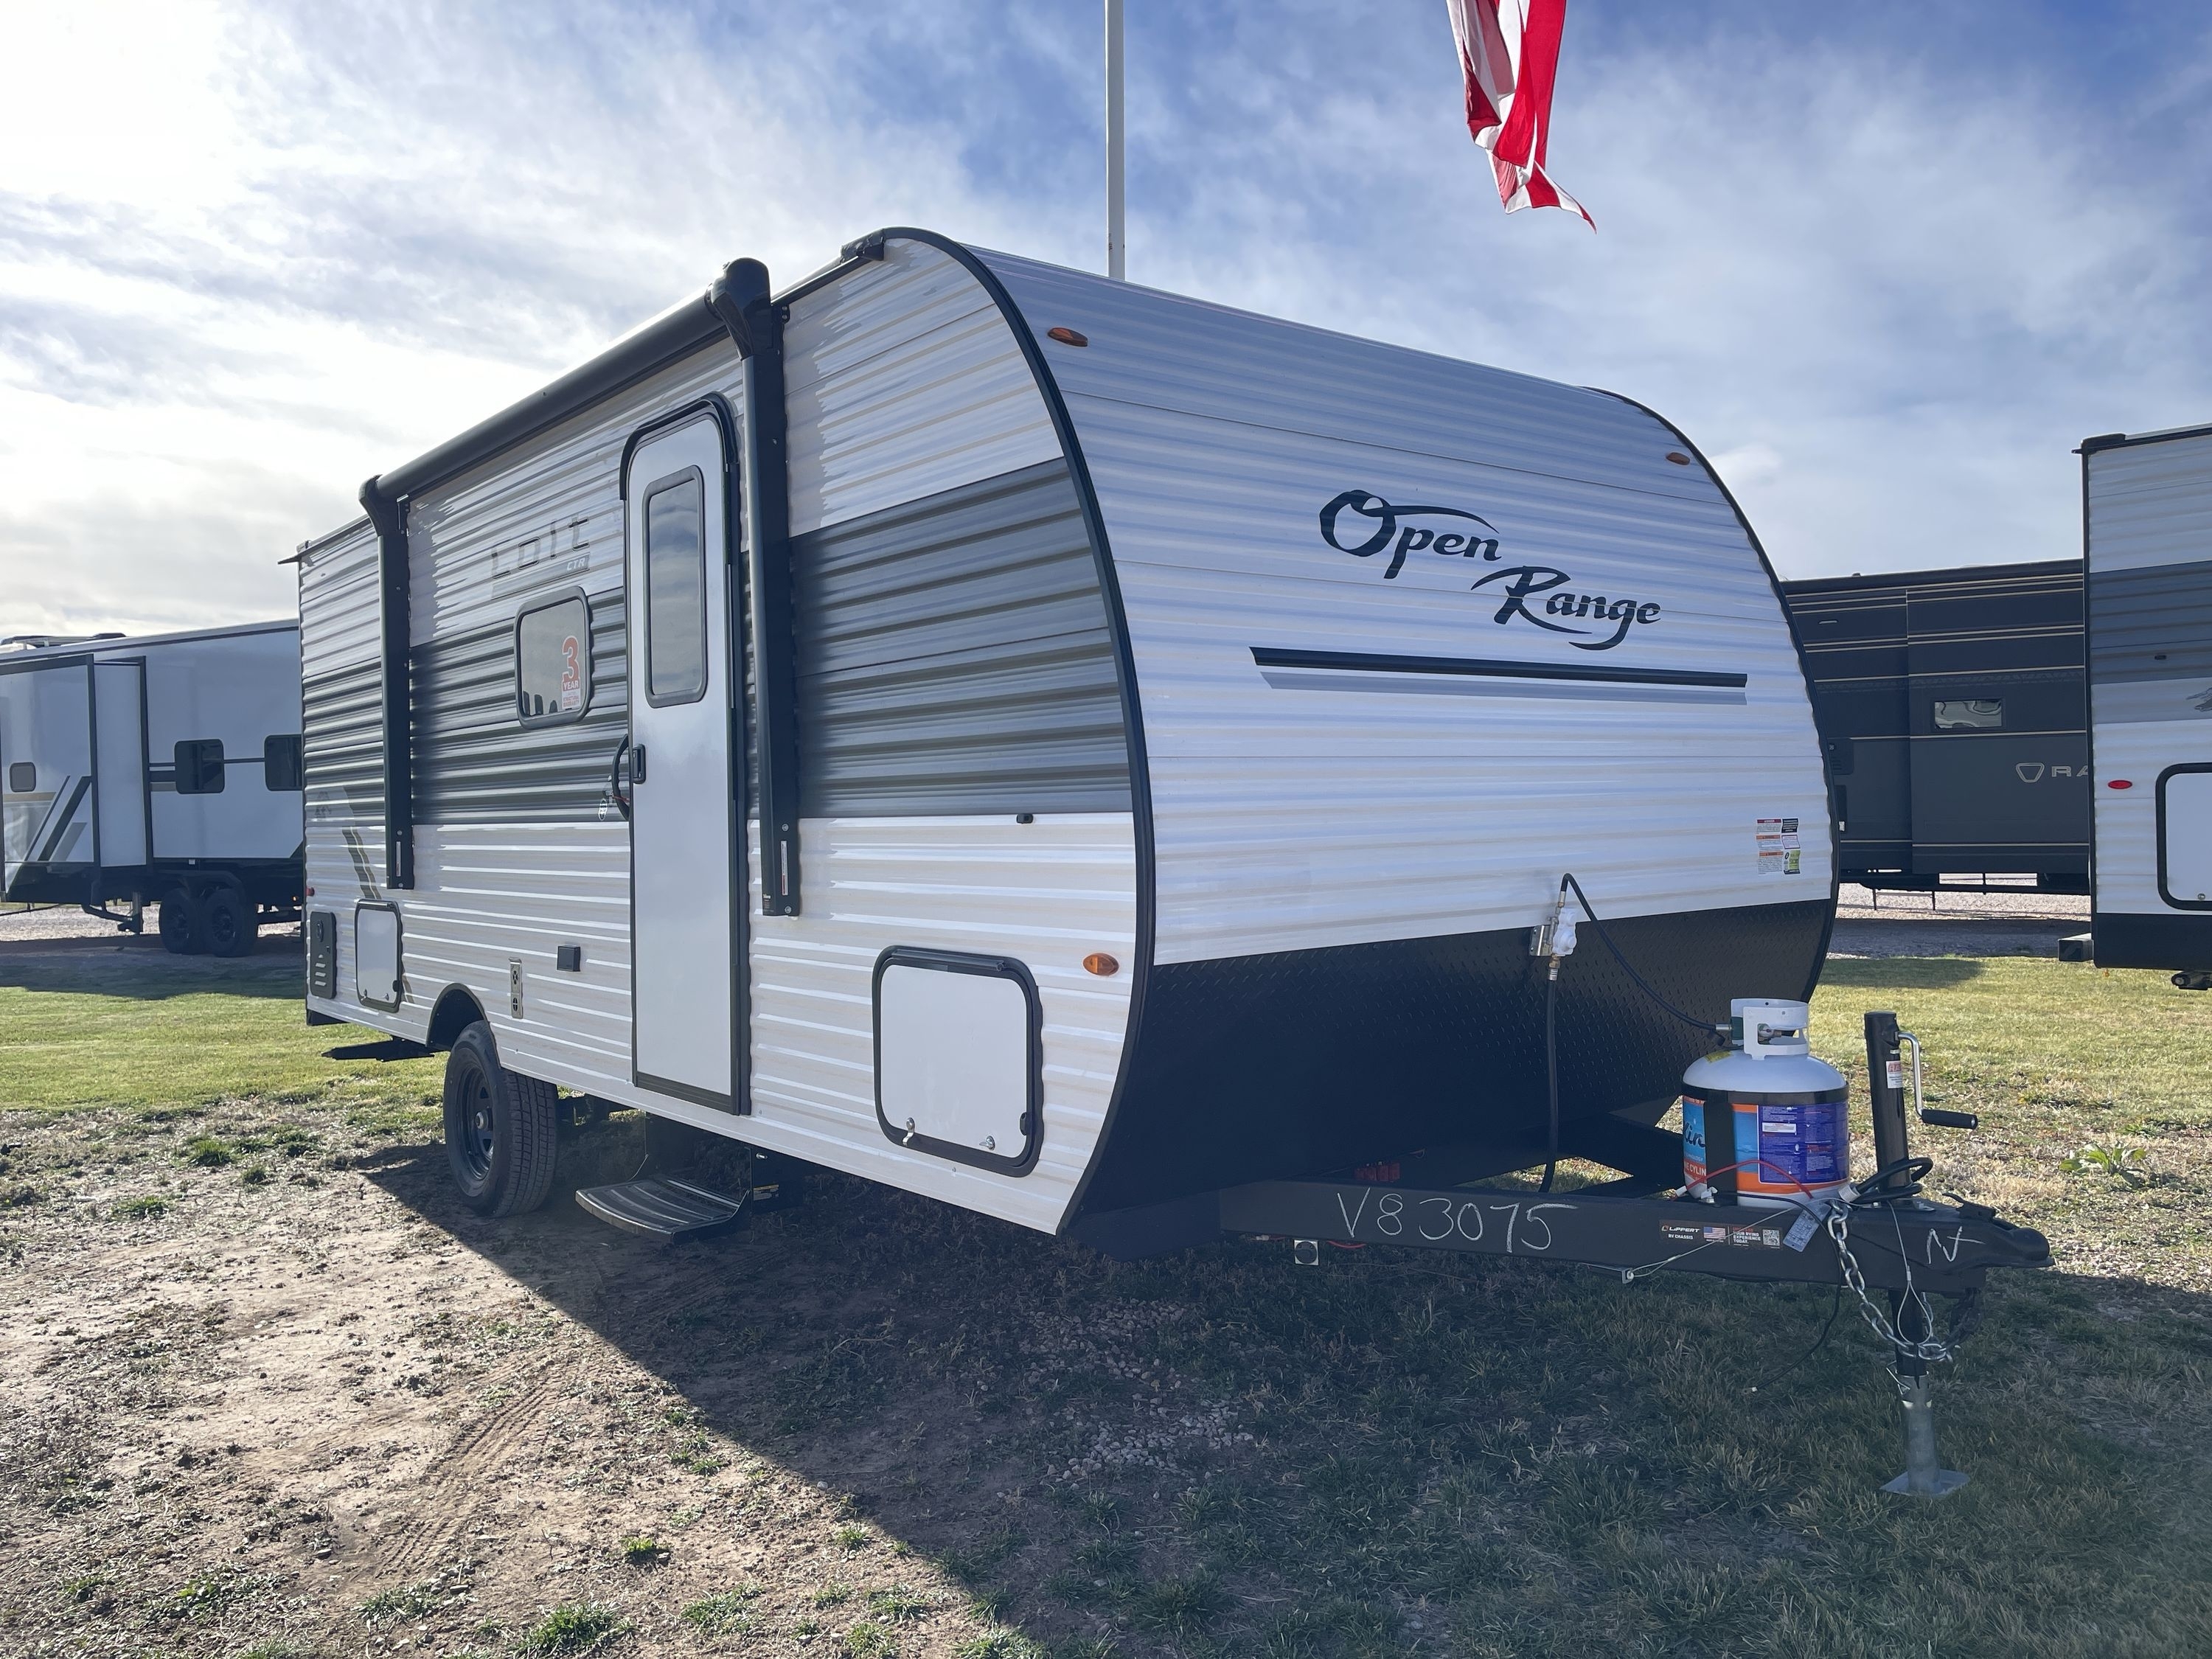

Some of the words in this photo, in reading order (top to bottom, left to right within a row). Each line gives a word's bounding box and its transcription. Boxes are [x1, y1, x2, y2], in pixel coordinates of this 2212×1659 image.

[1319, 490, 1501, 579] Open
[567, 557, 585, 571] CTR
[1471, 566, 1661, 650] Range
[562, 636, 580, 682] 3
[563, 681, 579, 690] YEAR
